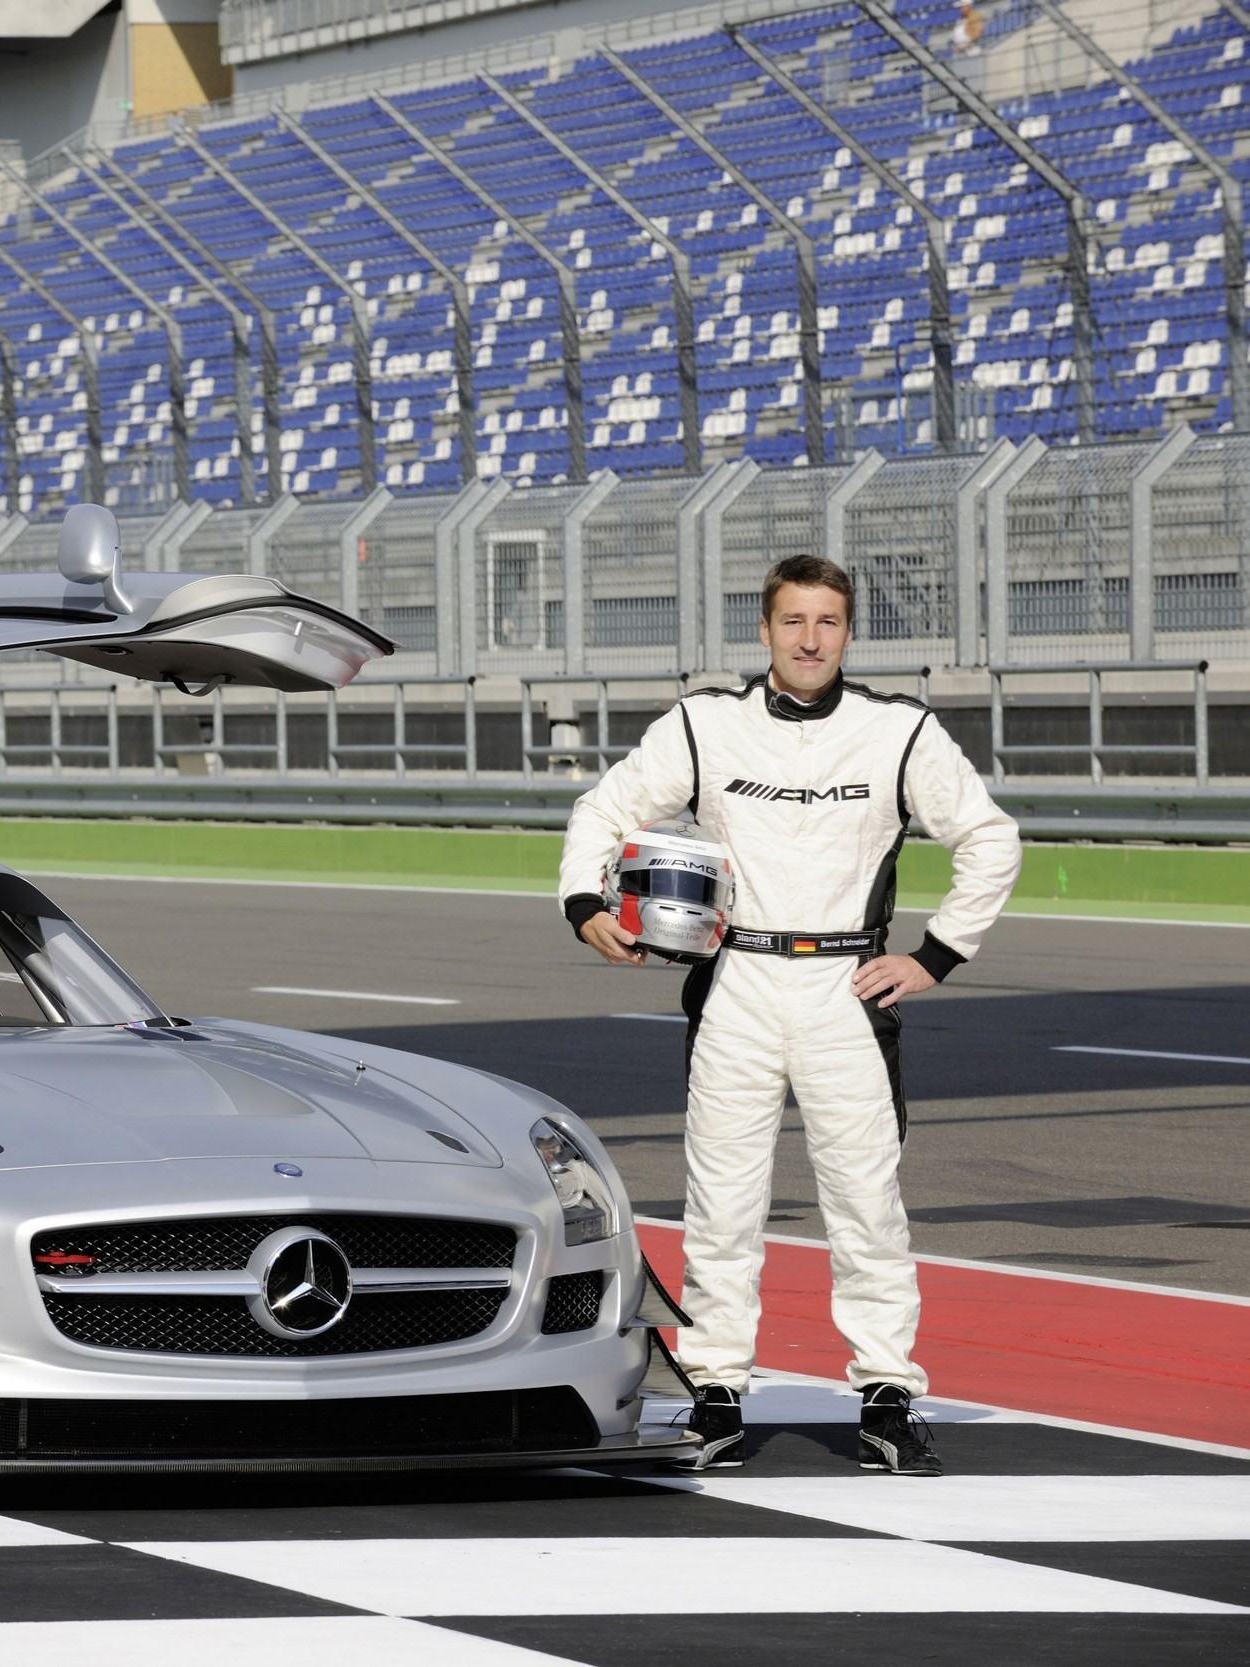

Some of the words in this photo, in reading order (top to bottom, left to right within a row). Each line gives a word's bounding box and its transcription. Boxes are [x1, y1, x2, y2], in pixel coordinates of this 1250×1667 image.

[768, 782, 871, 805] AMG
[670, 859, 718, 877] AMG
[820, 939, 841, 948] Bernd
[842, 938, 871, 947] Schneider
